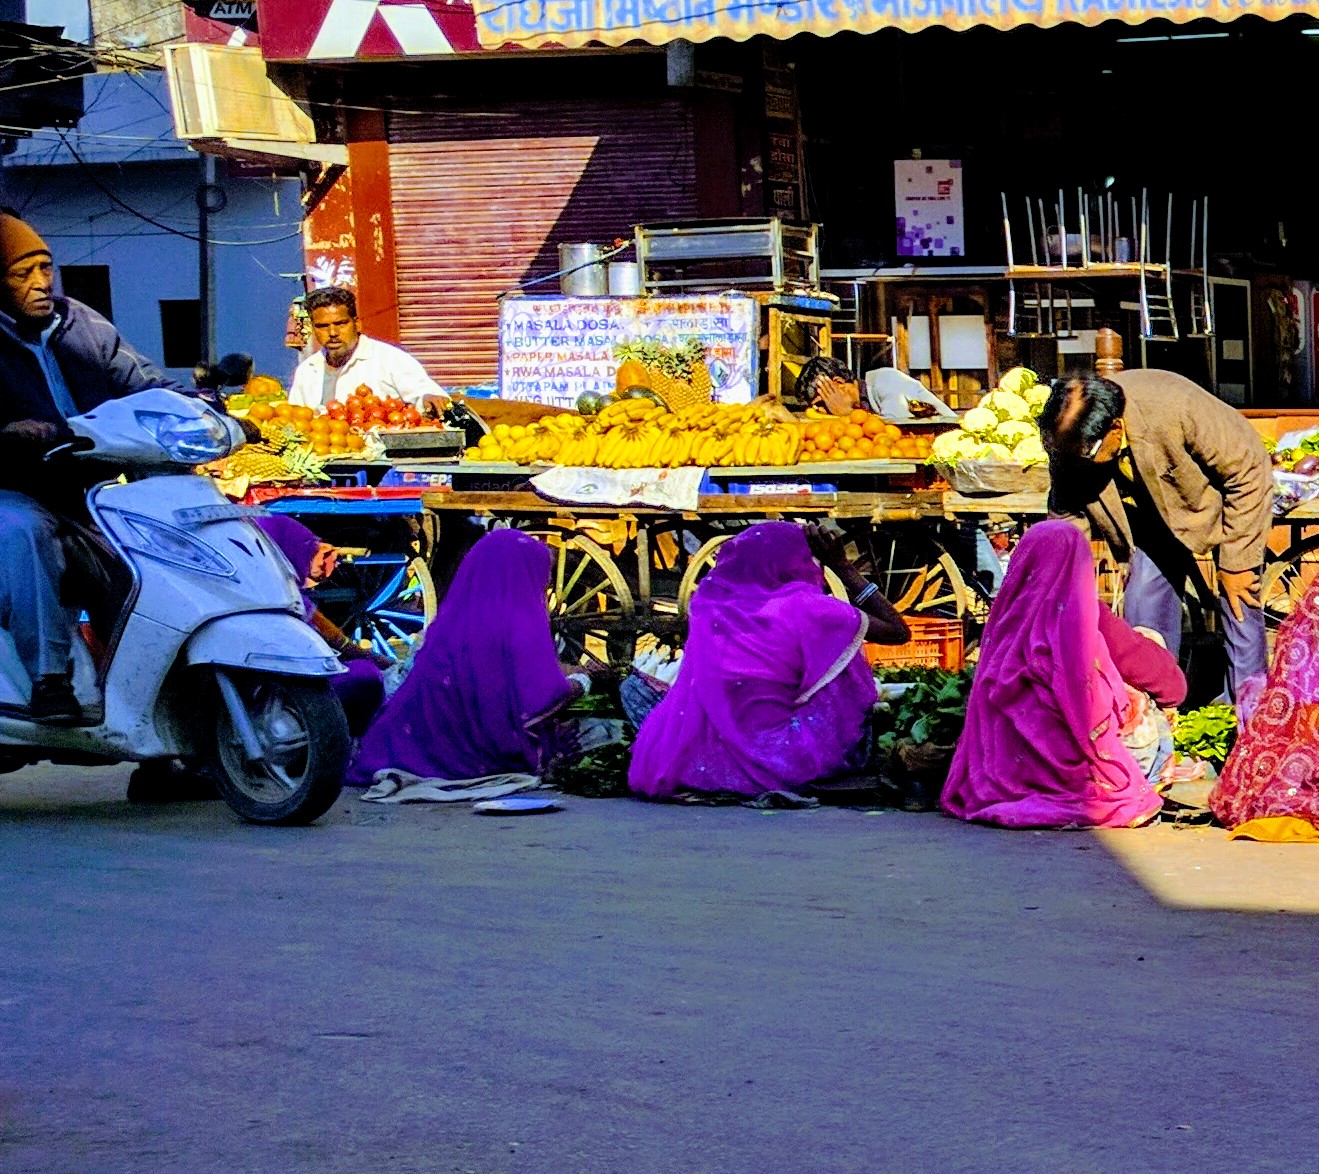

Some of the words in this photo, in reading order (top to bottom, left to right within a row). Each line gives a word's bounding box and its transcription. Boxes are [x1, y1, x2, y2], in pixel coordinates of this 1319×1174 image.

[214, 1, 252, 14] ATM
[514, 319, 572, 332] MASALA
[514, 336, 569, 348] BUTTER
[512, 351, 553, 363] PAPER
[556, 350, 609, 363] MASALA
[512, 366, 542, 378] RWA
[544, 366, 601, 378] MASALA
